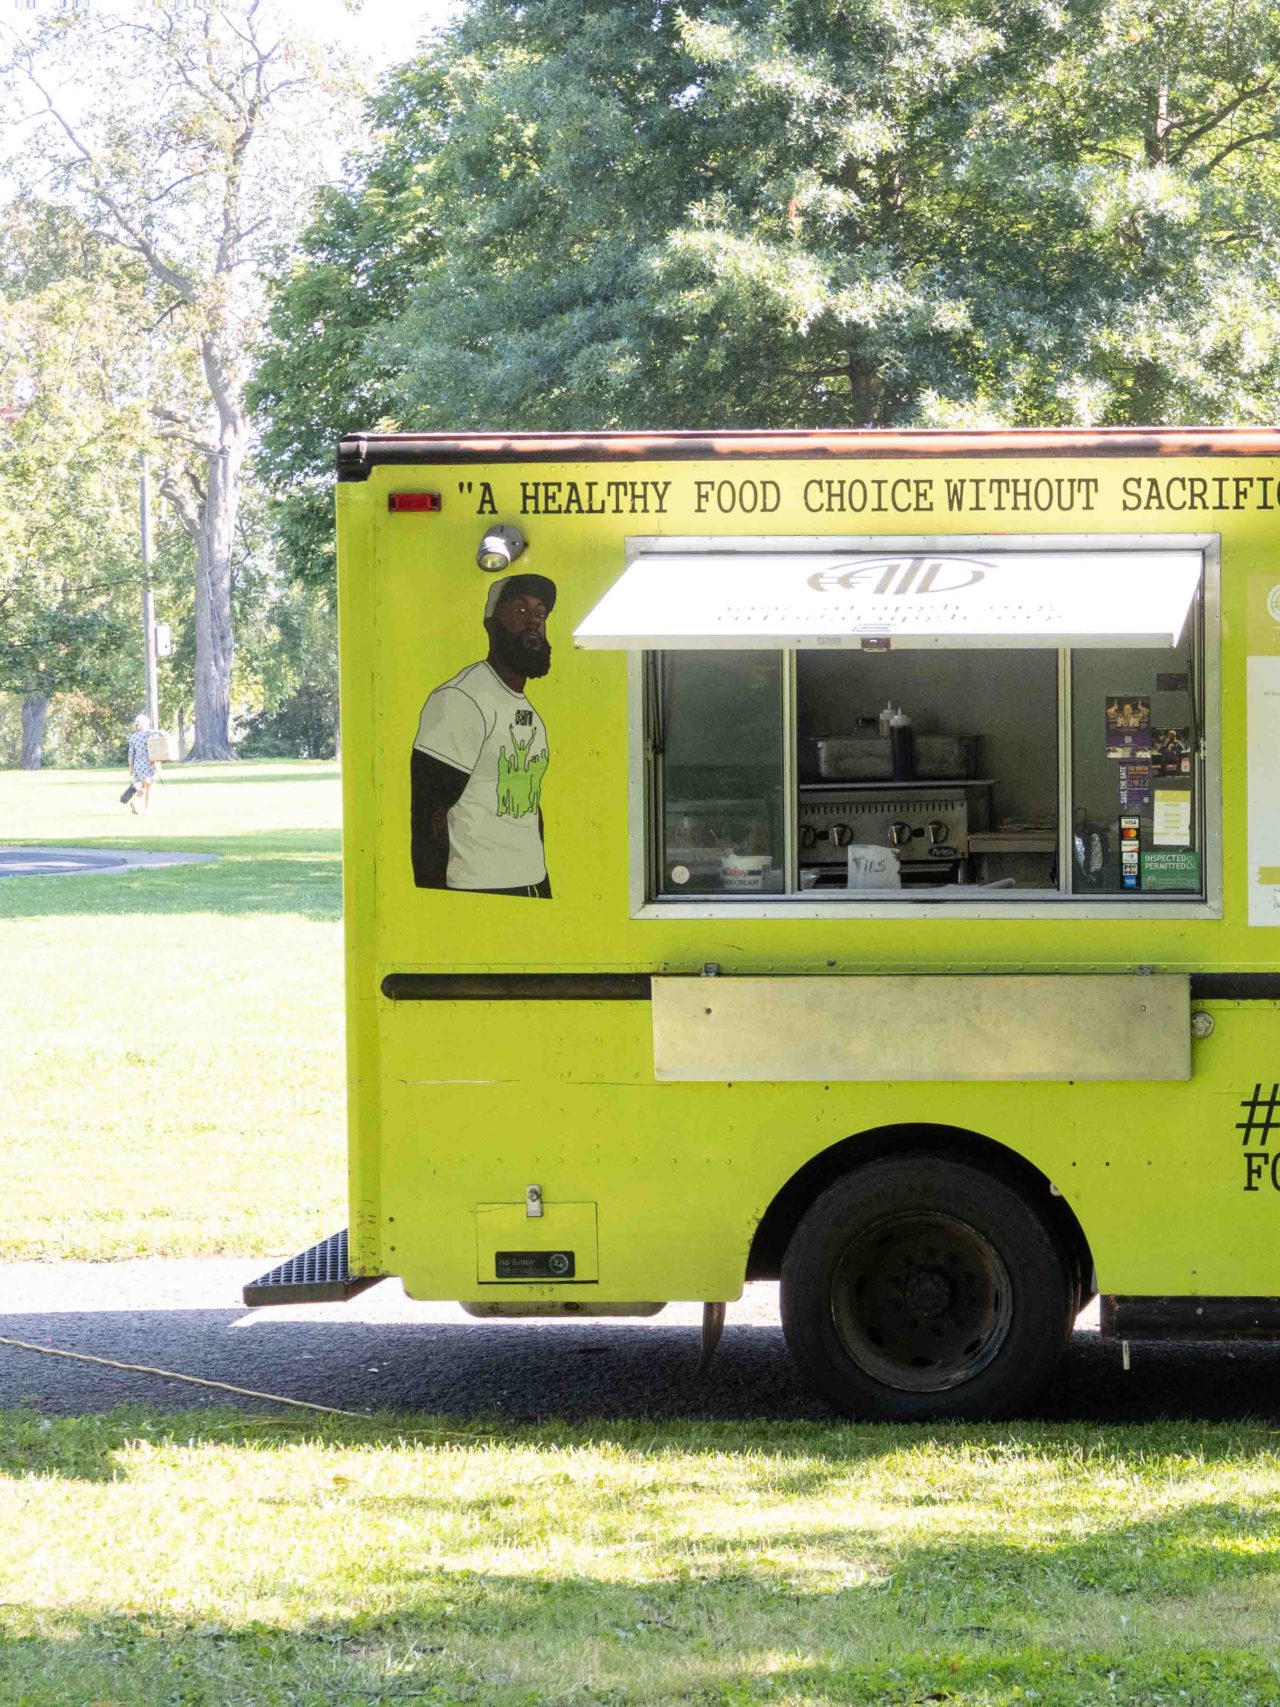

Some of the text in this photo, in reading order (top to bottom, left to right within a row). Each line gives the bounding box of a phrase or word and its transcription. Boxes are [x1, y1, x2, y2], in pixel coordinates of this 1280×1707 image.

[457, 481, 498, 514] "A
[520, 481, 672, 514] HEALTHY
[694, 480, 781, 513] FOOD
[803, 479, 933, 513] CHOICE
[945, 477, 1098, 512] WITHOUT
[1145, 854, 1186, 862] INSPECTED
[1145, 862, 1186, 870] PERMITTED
